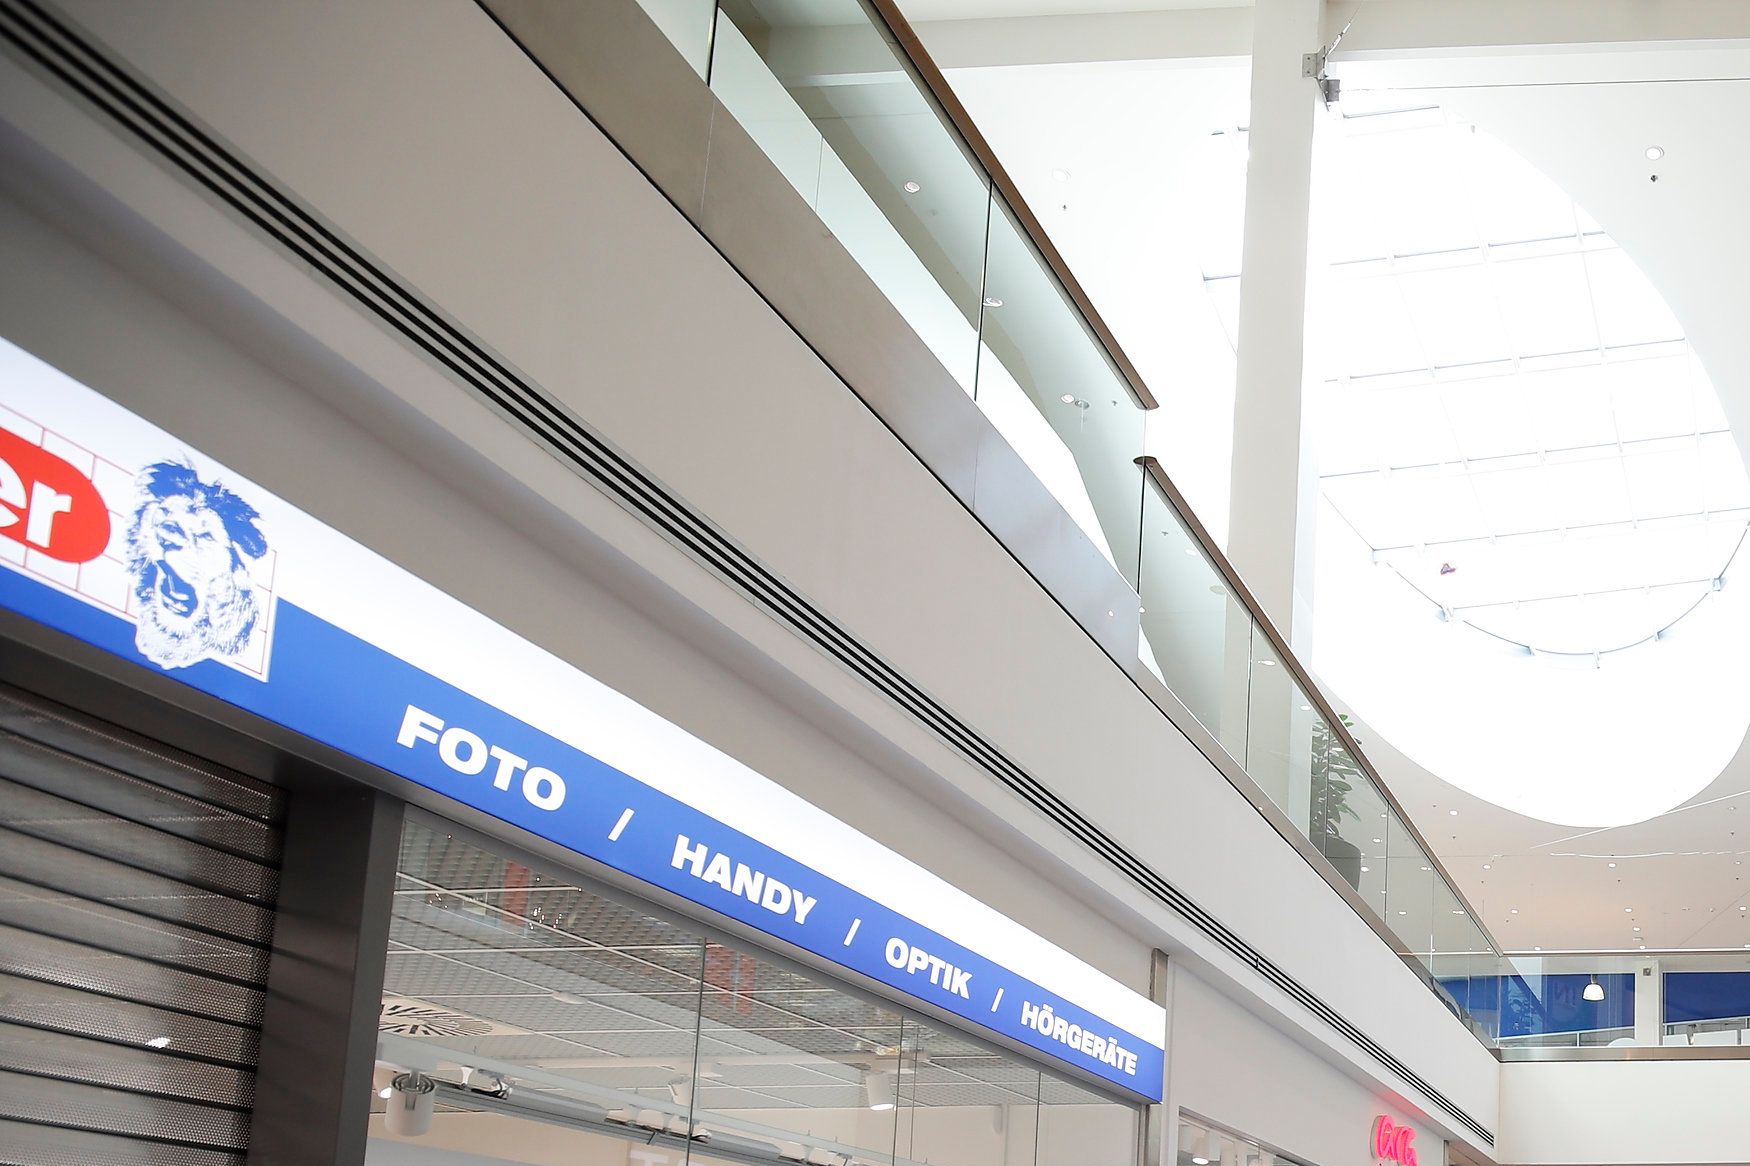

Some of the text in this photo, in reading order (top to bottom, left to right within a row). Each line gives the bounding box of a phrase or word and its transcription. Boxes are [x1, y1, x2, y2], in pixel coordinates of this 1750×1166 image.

[397, 704, 567, 811] FOTO
[671, 834, 817, 925] HANDY
[885, 937, 973, 999] OPTIK
[1021, 1000, 1138, 1076] HÖRGERÄTE
